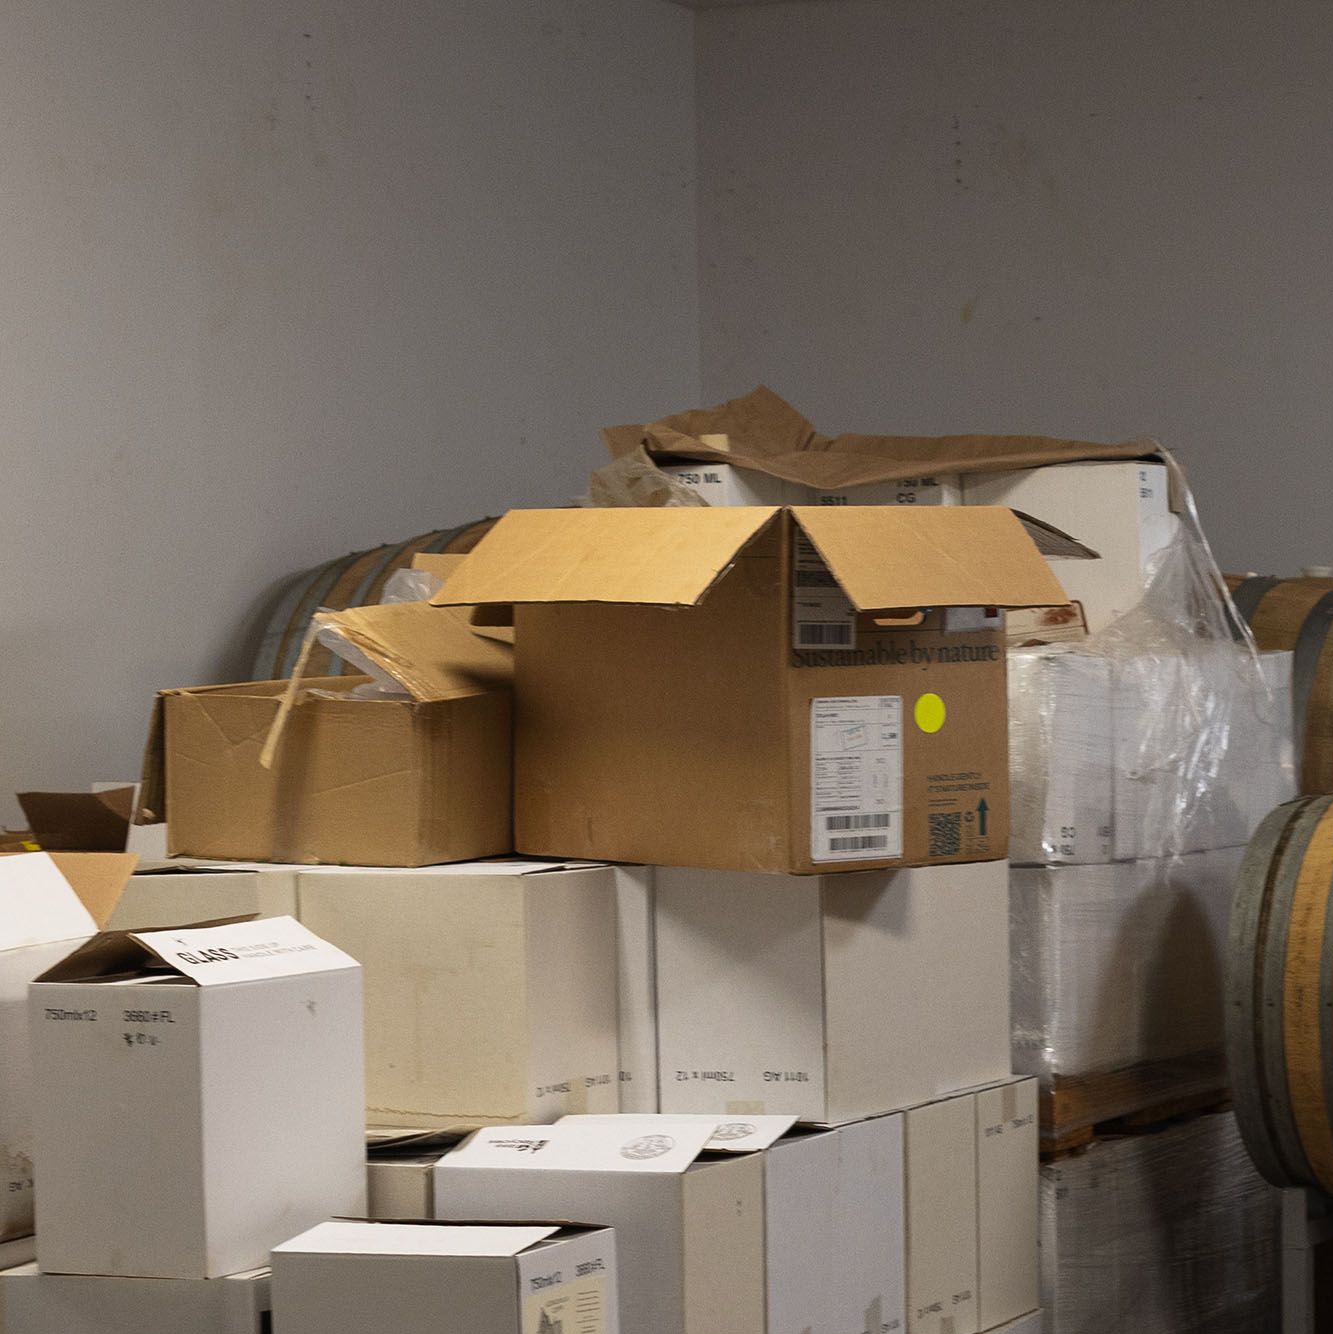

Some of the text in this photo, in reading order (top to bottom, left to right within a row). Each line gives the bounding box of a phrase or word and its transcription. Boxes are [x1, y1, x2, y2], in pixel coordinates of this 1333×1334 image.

[896, 492, 917, 504] CG
[792, 639, 1000, 669] Sustainable by nature
[176, 947, 240, 965] GLASS
